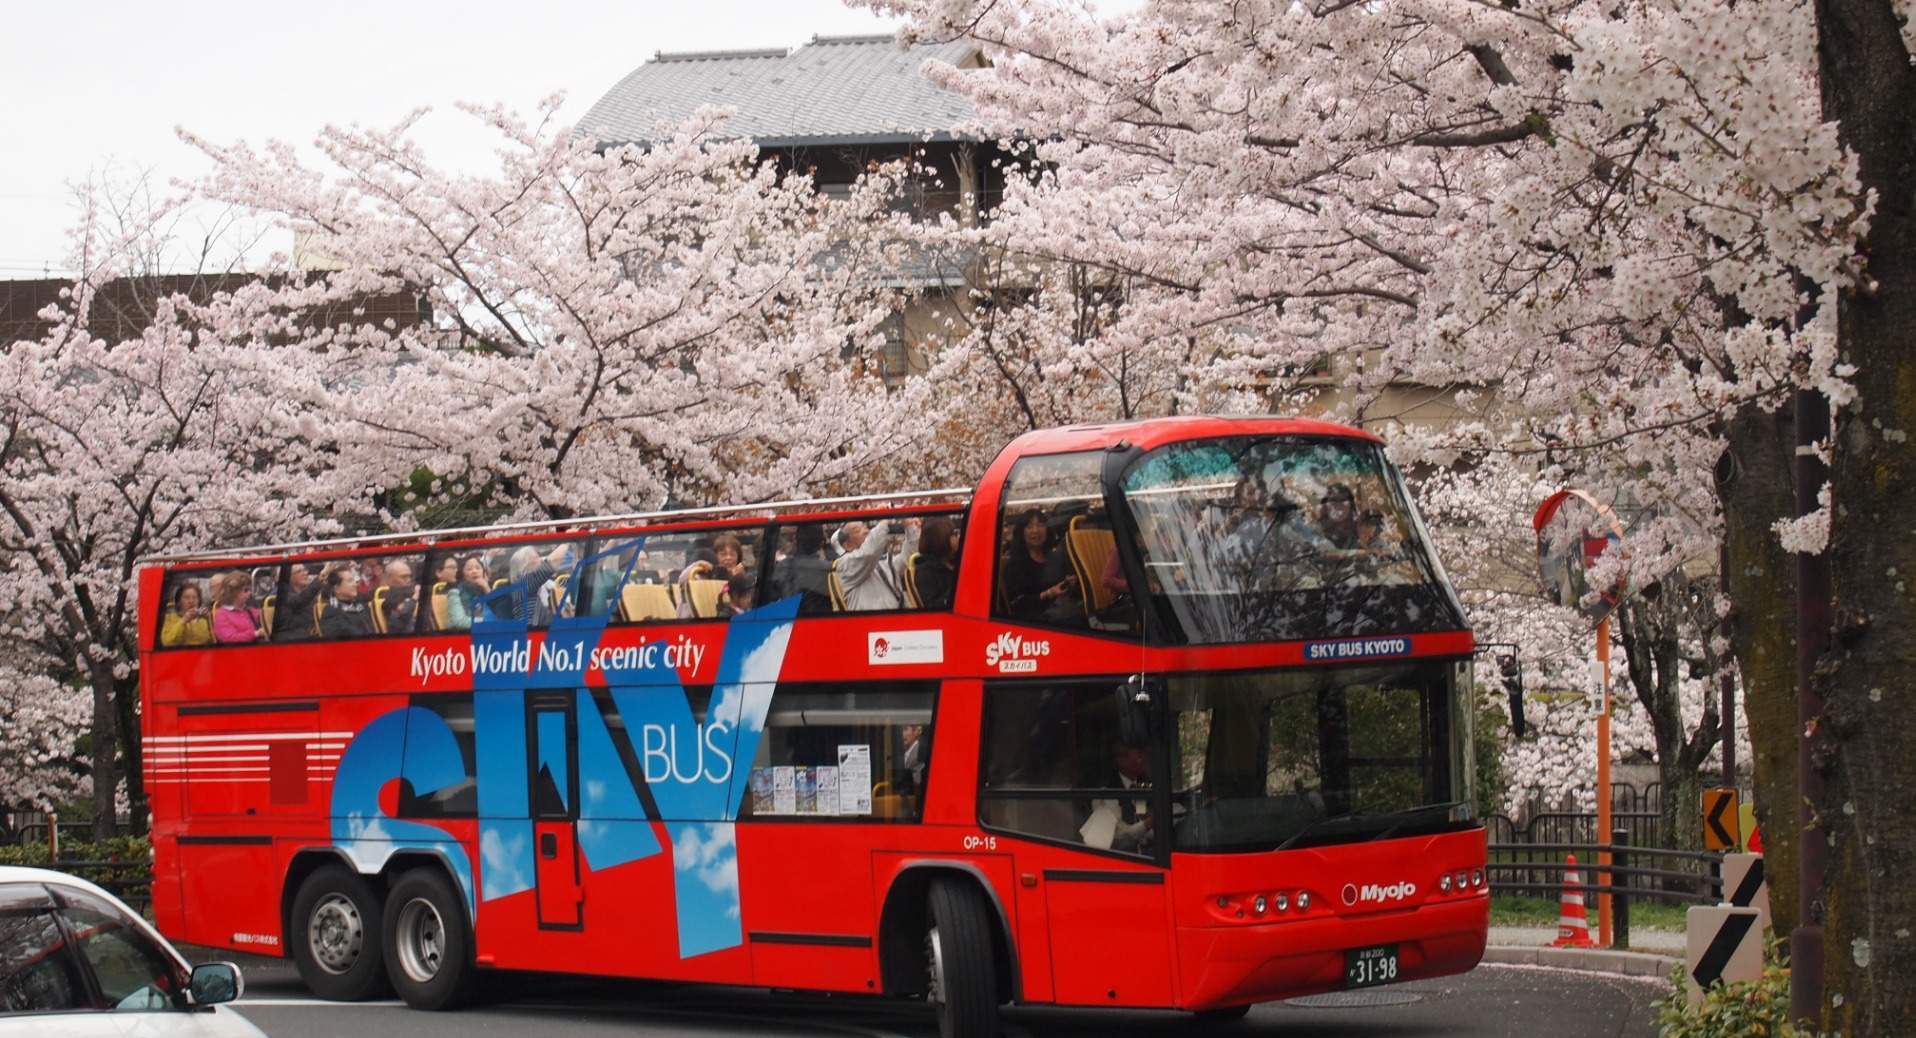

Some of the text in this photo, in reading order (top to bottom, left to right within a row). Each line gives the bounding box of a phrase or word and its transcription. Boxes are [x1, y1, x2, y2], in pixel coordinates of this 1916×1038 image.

[411, 634, 706, 686] Kyoto World No.1 scenic city
[986, 631, 1051, 666] SKY BUS
[1310, 639, 1406, 659] SKY BUS KYOTO
[643, 722, 733, 784] BUS
[963, 835, 997, 850] OP-15
[1360, 881, 1416, 903] Myojo
